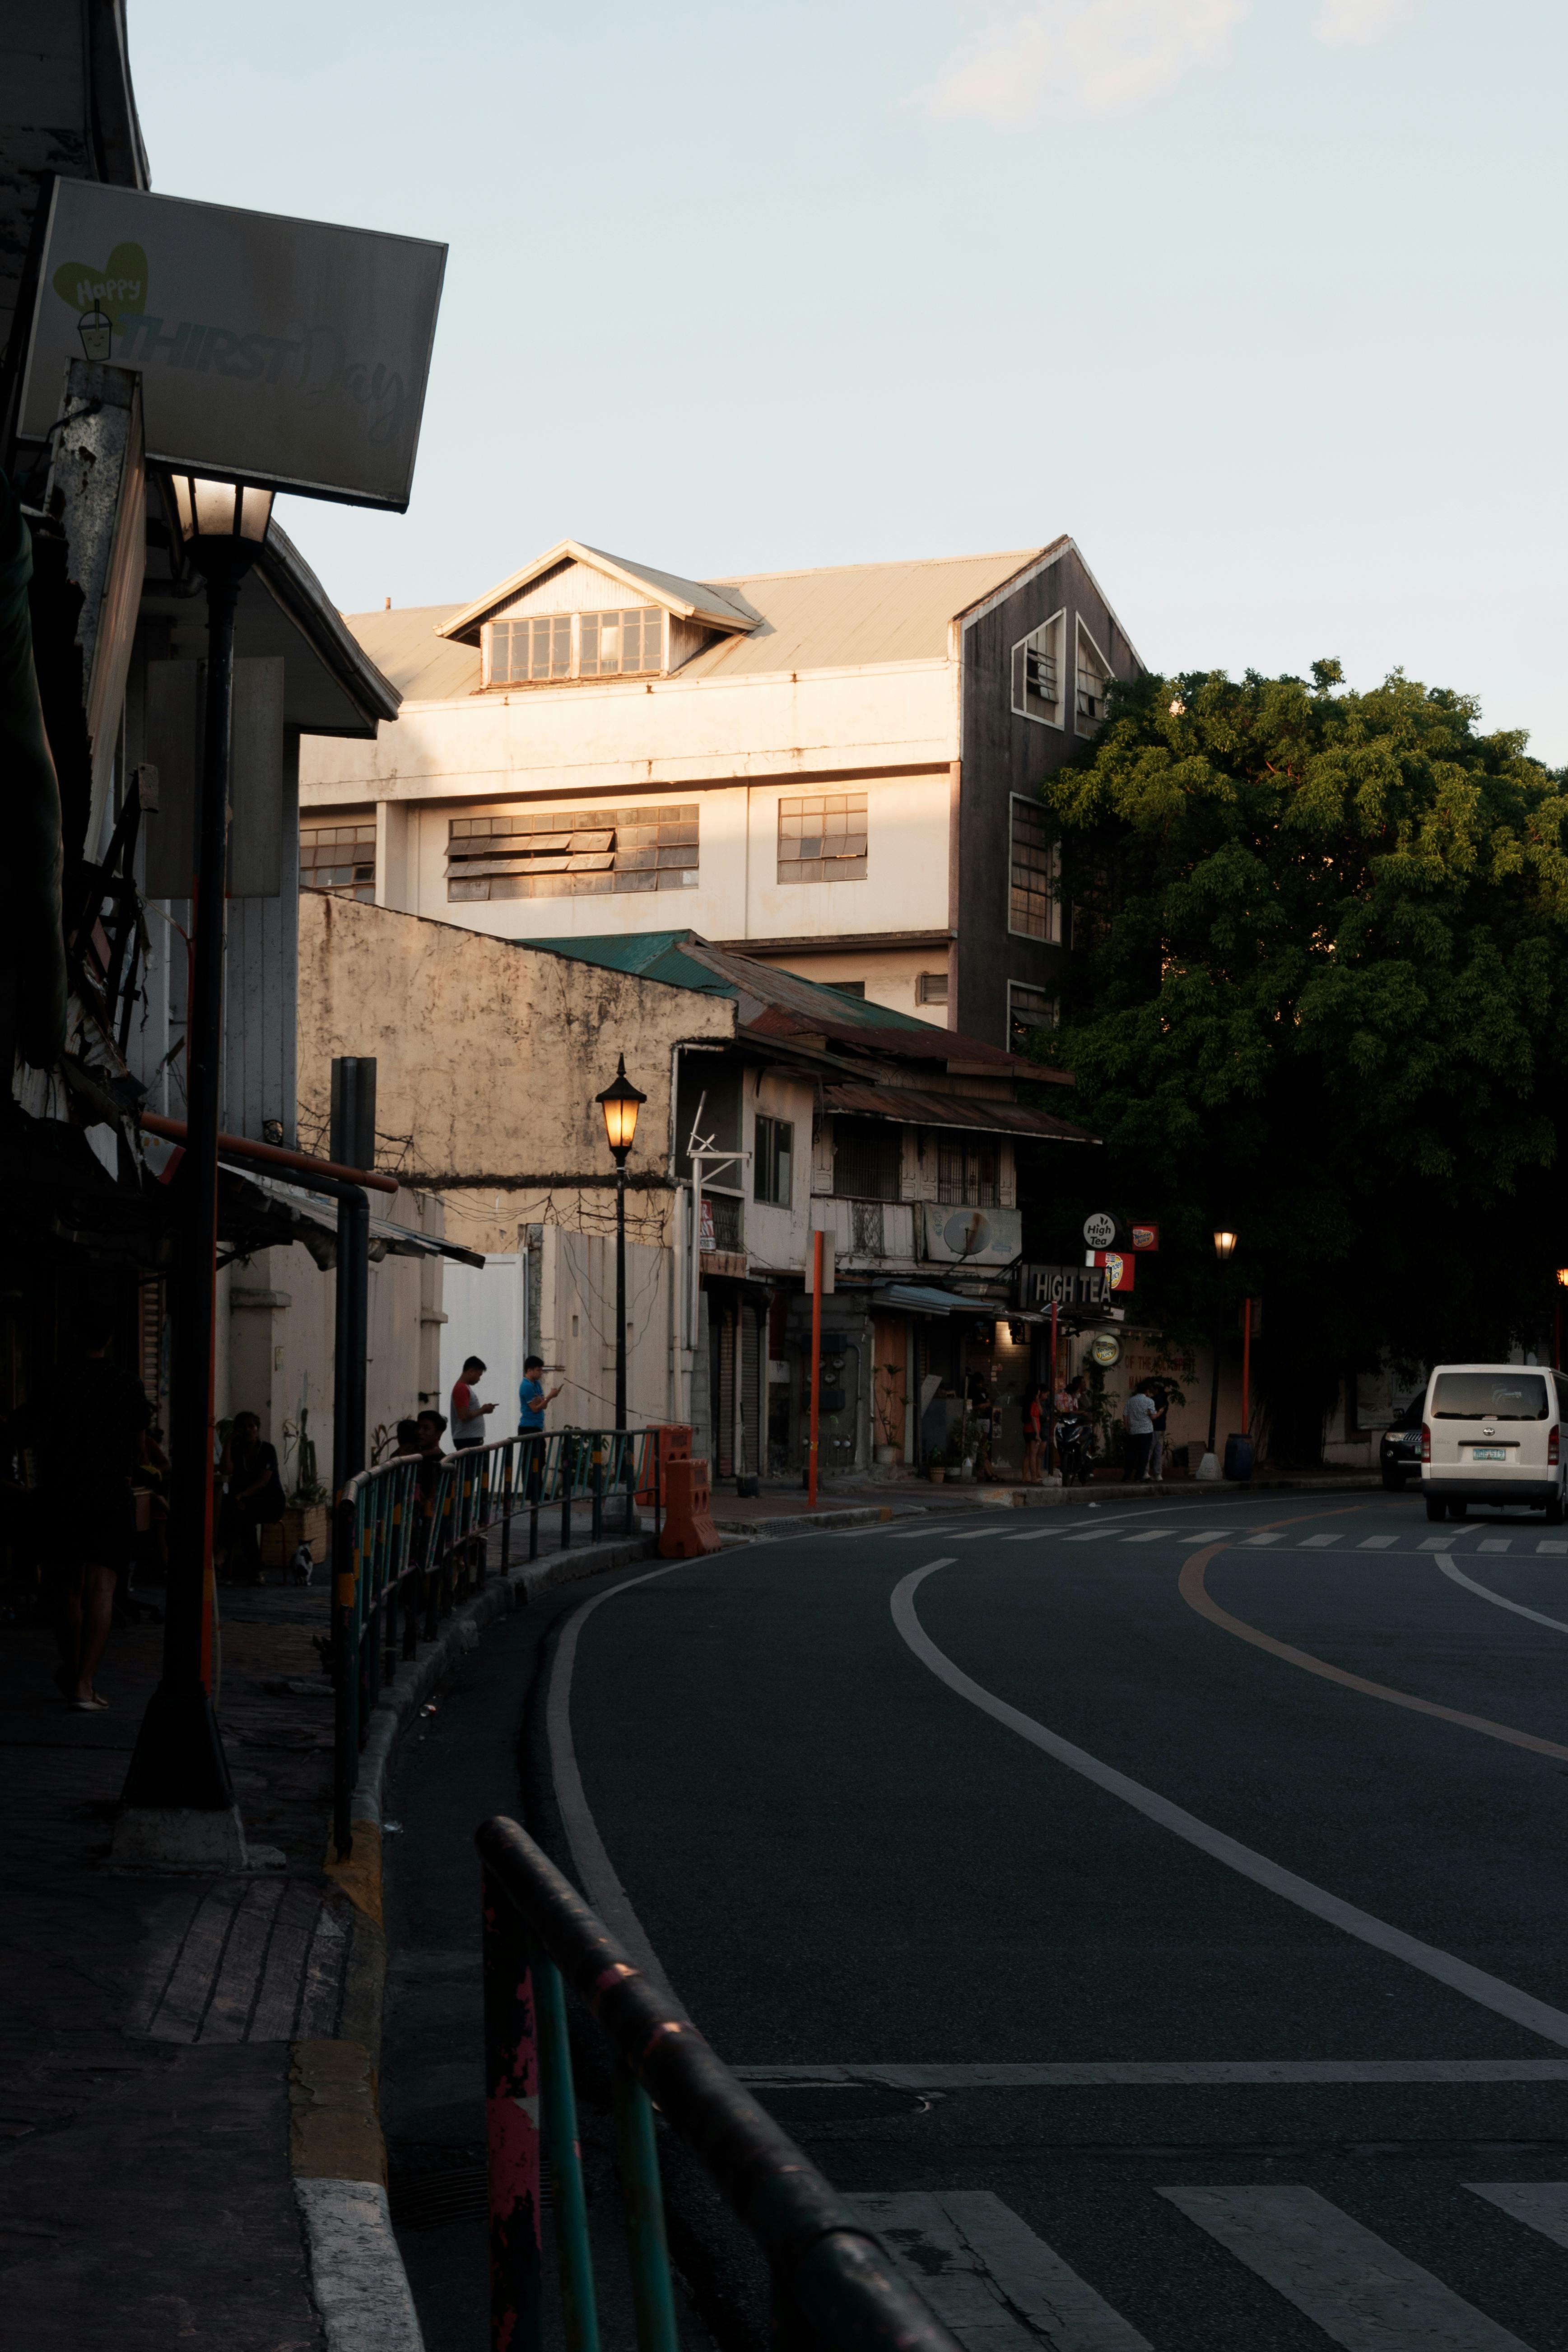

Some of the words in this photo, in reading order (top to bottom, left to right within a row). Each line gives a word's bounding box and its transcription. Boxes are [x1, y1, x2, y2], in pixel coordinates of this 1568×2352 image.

[76, 276, 142, 306] Happy
[118, 312, 306, 385] THIRST
[1087, 1225, 1111, 1236] High
[1090, 1236, 1107, 1245] Tea
[1036, 1274, 1075, 1302] HIGH
[1079, 1276, 1111, 1303] TEA
[1125, 1355, 1134, 1369] OF
[1138, 1356, 1151, 1370] THE
